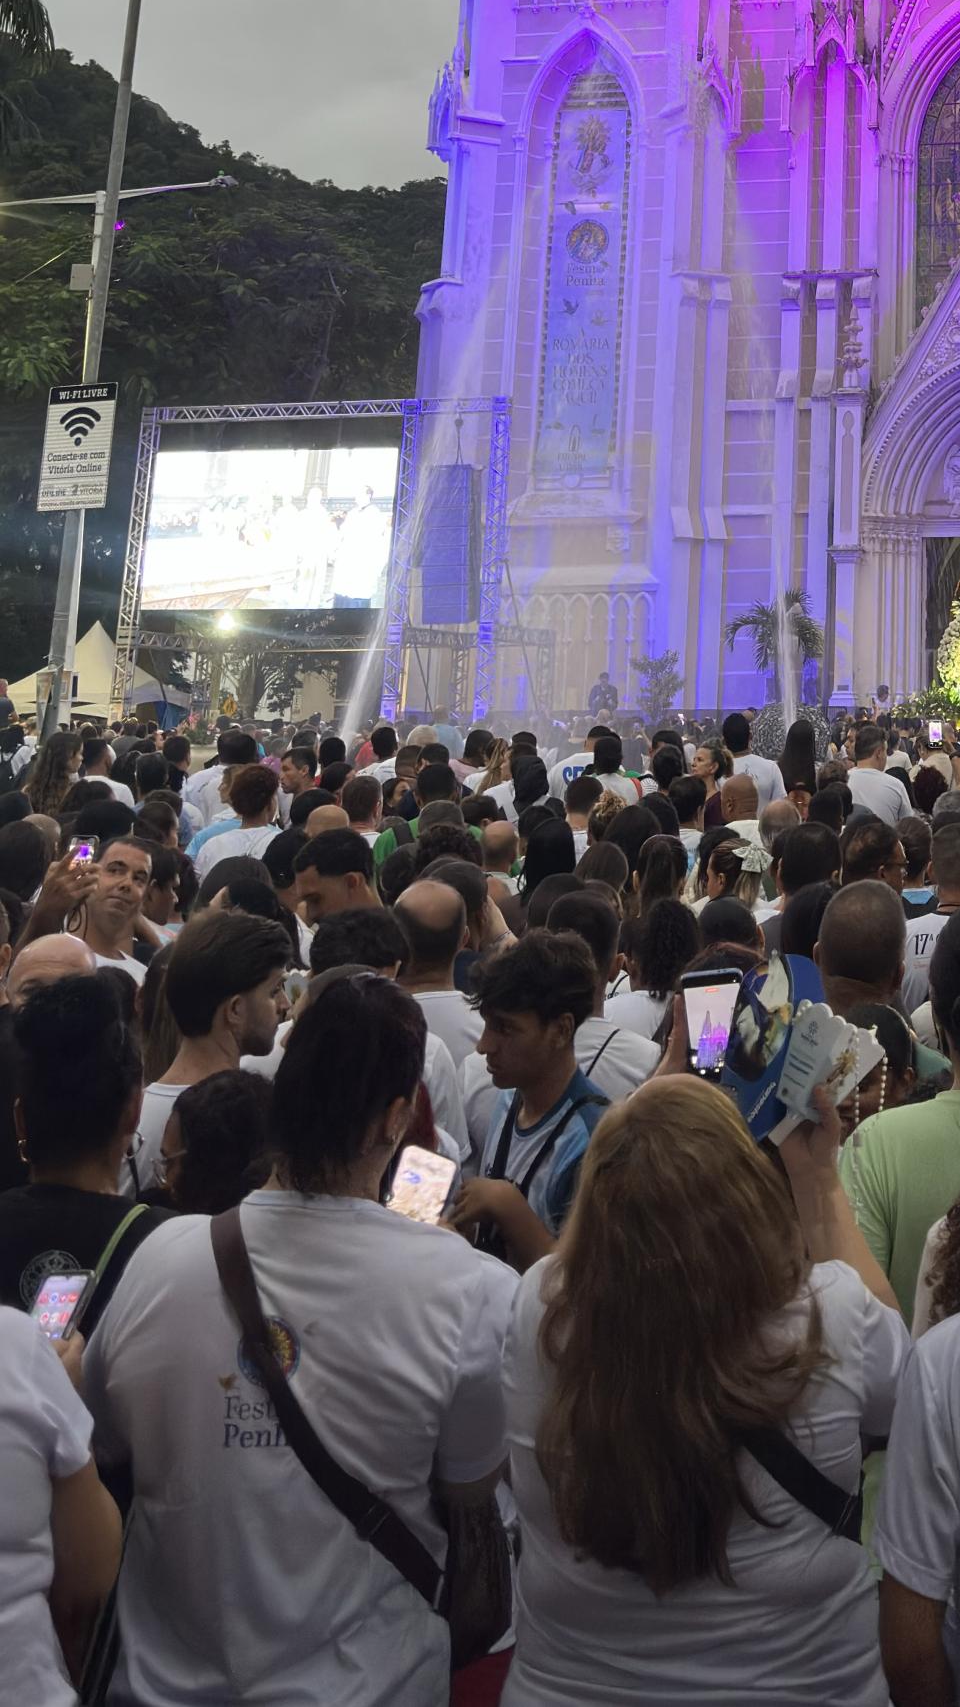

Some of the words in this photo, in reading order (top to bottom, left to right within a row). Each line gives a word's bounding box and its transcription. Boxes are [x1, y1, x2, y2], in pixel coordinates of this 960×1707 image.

[552, 337, 609, 350] ROMARIA
[567, 352, 594, 364] DOS
[553, 365, 608, 378] HOMENS
[59, 390, 81, 400] WI-FI
[82, 388, 108, 398] LIVRE
[47, 452, 88, 462] Conecte-se
[90, 451, 106, 459] com
[48, 464, 74, 474] Vitória
[76, 463, 102, 473] Online
[224, 1396, 276, 1422] Fest
[224, 1422, 288, 1449] Penh
